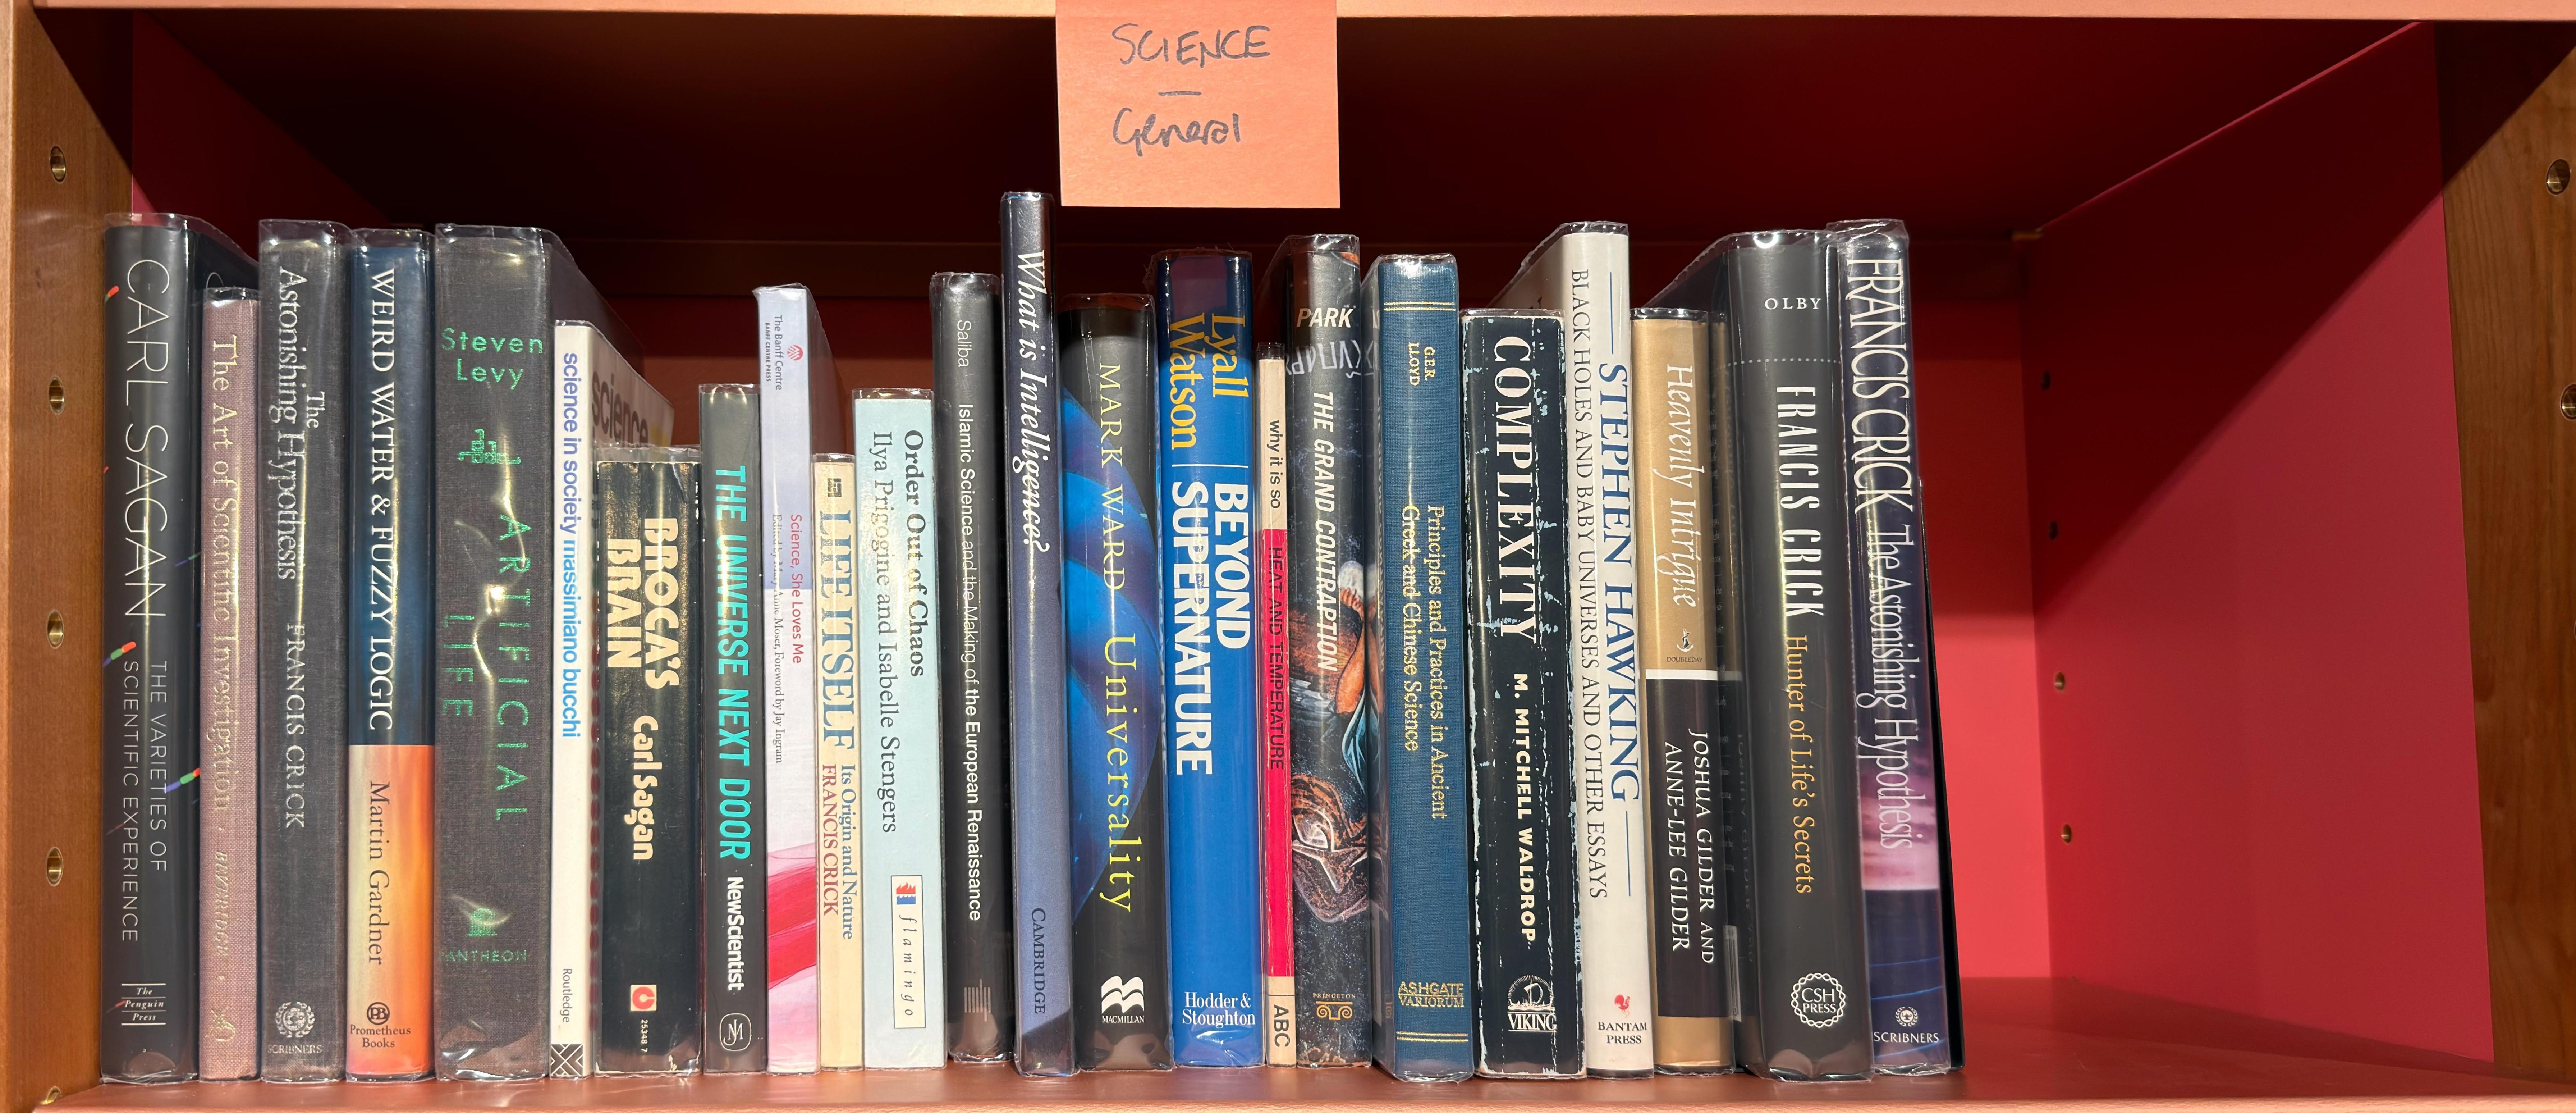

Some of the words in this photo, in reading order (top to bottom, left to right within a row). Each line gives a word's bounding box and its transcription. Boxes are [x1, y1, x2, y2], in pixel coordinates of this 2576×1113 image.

[1112, 23, 1270, 68] SCIENCE
[1113, 108, 1241, 157] General
[371, 268, 395, 372] WEIRD
[775, 315, 783, 331] The
[1018, 250, 1046, 331] What
[1296, 308, 1354, 328] PARK
[1572, 269, 1590, 342] BLACK
[1765, 298, 1821, 310] OLBY
[127, 259, 169, 406] CARL
[269, 267, 307, 424] Astonishing
[441, 328, 544, 354] Steven
[775, 334, 784, 359] Banff
[957, 320, 971, 367] Saliba
[1021, 338, 1045, 361] is
[1211, 315, 1249, 398] Lyall
[1408, 342, 1420, 386] LLOYD
[1846, 258, 1910, 400] FRANCIS
[306, 391, 325, 428] The
[457, 359, 523, 389] Levy
[563, 352, 579, 432] science
[775, 361, 784, 390] Centre
[1169, 313, 1205, 450] Watson
[1574, 349, 1591, 421] HOLES
[371, 383, 395, 483] WATER
[563, 438, 578, 453] in
[1099, 364, 1123, 468] MARK
[1267, 420, 1283, 452] why
[1313, 392, 1334, 432] THE
[1653, 364, 1704, 489] Heavenly
[1777, 386, 1820, 509] FRANCIS
[870, 431, 892, 471] Ilya
[905, 430, 924, 506] Order
[1013, 367, 1050, 552] Intelligence?
[1270, 457, 1283, 466] it
[1270, 472, 1283, 484] is
[1314, 439, 1335, 513] GRAND
[1576, 429, 1593, 479] AND
[1599, 363, 1631, 567] STEPHEN
[1851, 409, 1915, 514] CRICK
[125, 423, 168, 616] SAGAN
[268, 430, 306, 580] Hypothesis
[371, 494, 391, 516] &
[559, 460, 578, 534] society
[716, 466, 746, 522] THE
[1271, 489, 1280, 508] so
[1494, 336, 1537, 643] COMPLEXITY
[1578, 487, 1595, 539] BABY
[791, 515, 802, 568] Science,
[820, 511, 852, 598] LIFE
[872, 480, 894, 587] Prigogine
[906, 514, 926, 561] Out
[1101, 483, 1125, 591] WARD
[1215, 484, 1251, 649] BEYOND
[1424, 505, 1447, 594] Principles
[1657, 497, 1701, 607] Intrigue
[1870, 524, 1914, 569] The
[371, 527, 395, 622] FUZZY
[562, 540, 577, 663] massimiano
[608, 538, 642, 668] BRAIN
[716, 535, 749, 675] UNIVERSE
[792, 573, 803, 597] She
[908, 567, 927, 594] of
[1314, 523, 1338, 672] CONTRAPTION
[1781, 528, 1825, 617] CRICK
[774, 617, 784, 649] Moser,
[792, 602, 803, 639] Loves
[877, 594, 896, 634] and
[909, 601, 929, 677] Chaos
[1172, 482, 1212, 775] SUPERNATURE
[1429, 600, 1447, 632] and
[1580, 551, 1599, 668] UNIVERSES
[1856, 573, 1920, 711] Astonishing
[151, 662, 167, 703] THE
[287, 624, 305, 737] FRANCIS
[370, 635, 393, 730] LOGIC
[775, 652, 784, 695] Foreword
[793, 644, 804, 663] Me
[821, 608, 854, 750] ITSELF
[878, 642, 898, 728] Isabelle
[1429, 638, 1448, 720] Practices
[1514, 674, 1527, 698] M.
[1786, 635, 1808, 712] Hunter
[123, 661, 139, 786] SCIENTIFIC
[562, 669, 581, 738] bucchi
[719, 689, 750, 766] NEXT
[773, 699, 785, 711] by
[773, 712, 785, 726] Jay
[1582, 675, 1601, 727] AND
[1605, 584, 1639, 802] HAWKING
[633, 716, 662, 770] Carl
[773, 730, 785, 763] Ingram
[1430, 724, 1448, 743] in
[1515, 708, 1532, 818] MITCHELL
[1789, 720, 1813, 743] of
[151, 715, 167, 830] VARIETIES
[285, 746, 305, 827] CRICK
[822, 764, 838, 849] FRANCIS
[841, 764, 856, 784] Its
[876, 737, 900, 832] Stengers
[1099, 634, 1142, 912] Universality
[1431, 745, 1449, 820] Ancient
[1585, 734, 1603, 814] OTHER
[1665, 742, 1687, 857] ANNE-LEE
[1688, 729, 1709, 818] JOSHUA
[1855, 718, 1926, 849] Hypothesis
[370, 781, 390, 860] Martin
[625, 776, 659, 860] Sagan
[719, 779, 751, 859] DOOR
[839, 788, 856, 841] Origin
[122, 797, 138, 941] EXPERIENCE
[151, 841, 167, 871] OF
[824, 853, 838, 916] CRICK
[842, 845, 857, 876] and
[1519, 827, 1536, 940] WALDROP
[1587, 821, 1607, 898] ESSAYS
[1697, 827, 1715, 912] GILDER
[1793, 816, 1814, 893] Secrets
[368, 869, 390, 966] Gardner
[843, 880, 857, 940] Nature
[1670, 867, 1690, 950] GILDER
[1701, 922, 1714, 963] AND
[439, 949, 527, 962] PANTHEON
[897, 914, 916, 1016] flamingo
[1032, 908, 1046, 1014] CAMBRIDGE
[1398, 981, 1464, 995] ASHGATE
[125, 1000, 164, 1010] Penguin
[132, 1013, 156, 1021] Press
[350, 1024, 411, 1035] Prometheus
[562, 968, 572, 1022] Routledge
[1102, 1015, 1144, 1023] MACMILLAN
[1182, 1009, 1255, 1027] Stoughton
[1184, 992, 1238, 1008] Hodder
[1241, 993, 1251, 1007] &
[1274, 1006, 1290, 1047] ABC
[1508, 1014, 1557, 1031] VIKING
[1598, 1021, 1647, 1031] BANTAM
[1801, 987, 1835, 1003] CSH
[1803, 1003, 1837, 1013] PRESS
[363, 1037, 395, 1048] Books
[1606, 1035, 1641, 1044] PRESS
[1874, 1031, 1939, 1043] SCRIBNERS
